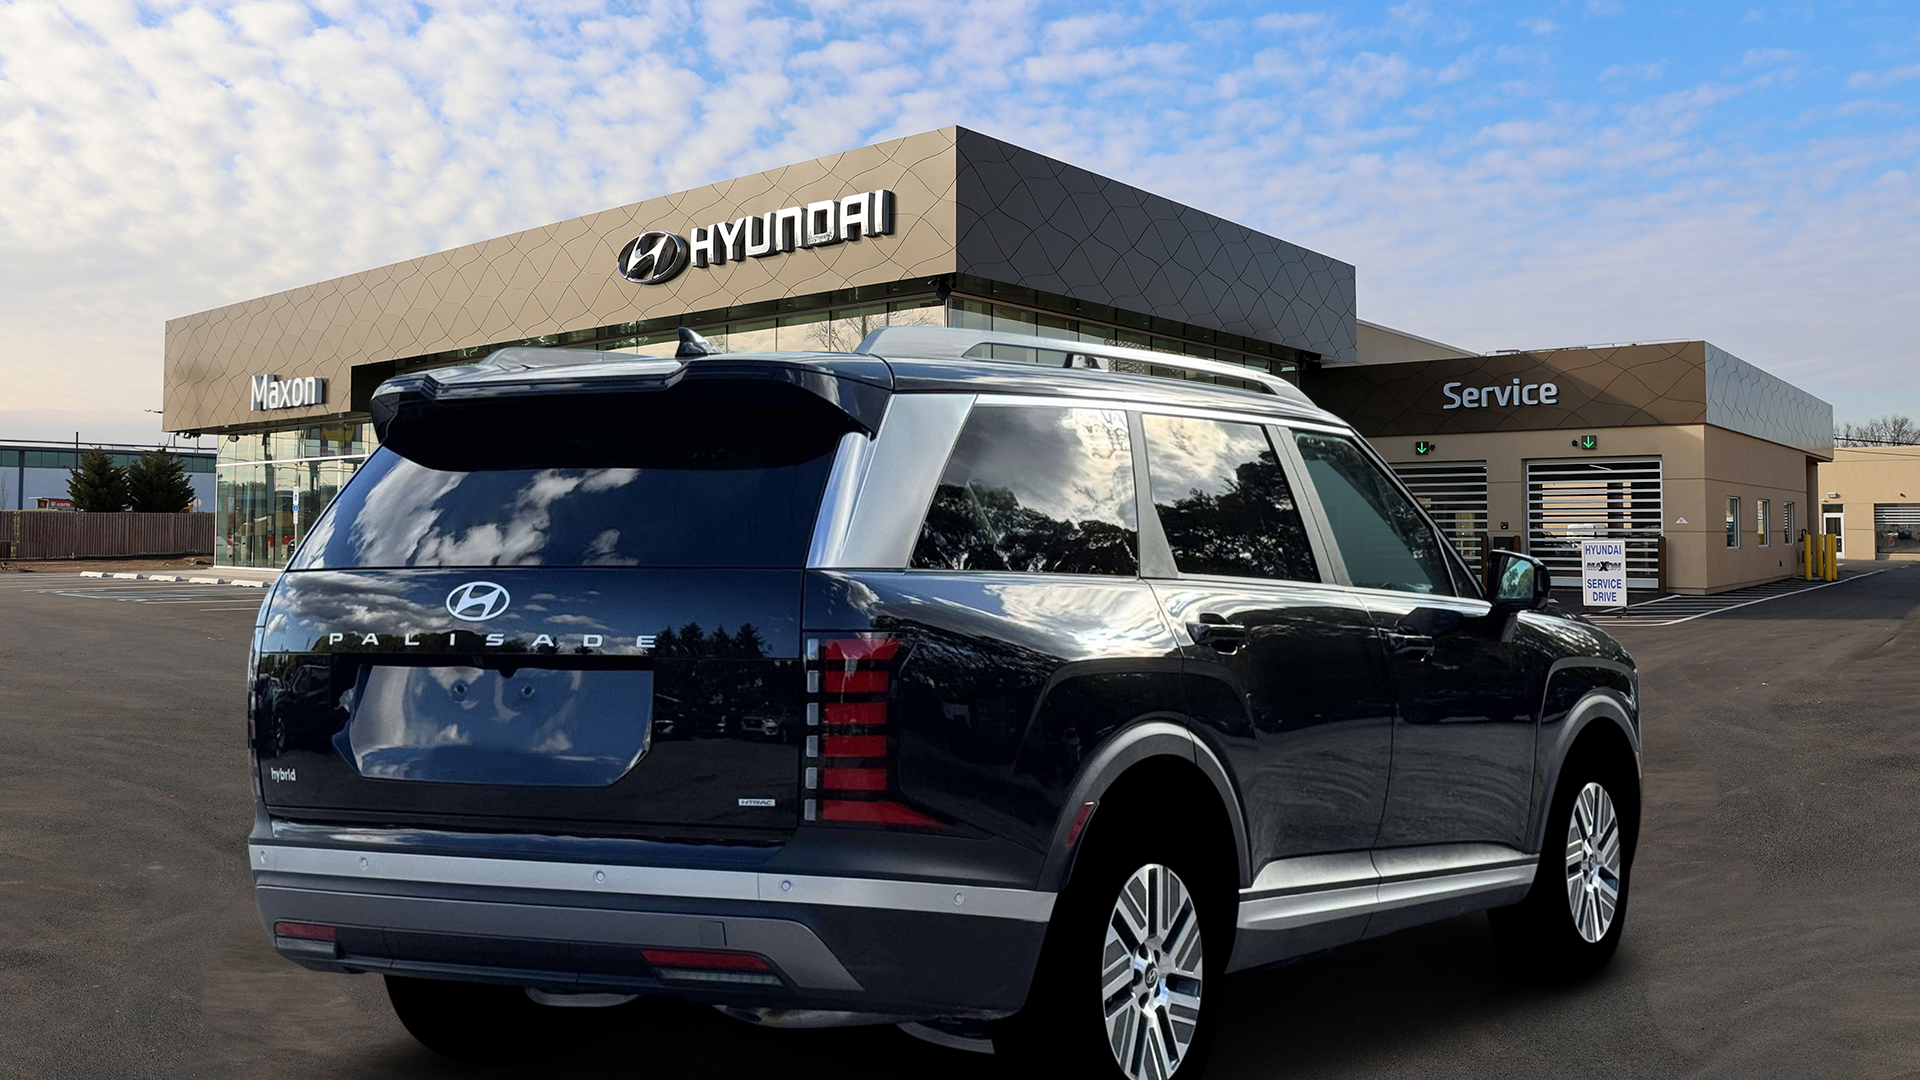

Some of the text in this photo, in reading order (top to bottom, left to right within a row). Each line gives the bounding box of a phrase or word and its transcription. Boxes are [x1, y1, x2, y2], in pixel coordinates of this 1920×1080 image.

[690, 189, 892, 268] HYUNDAI
[250, 374, 319, 411] Maxon
[1443, 378, 1558, 409] Service
[1585, 545, 1622, 555] HYUNDAI
[1586, 561, 1622, 571] MAXON
[1587, 579, 1622, 589] SERVICE
[1592, 592, 1617, 602] DRIVE
[328, 633, 657, 648] PALISADE
[270, 767, 296, 783] hybrid
